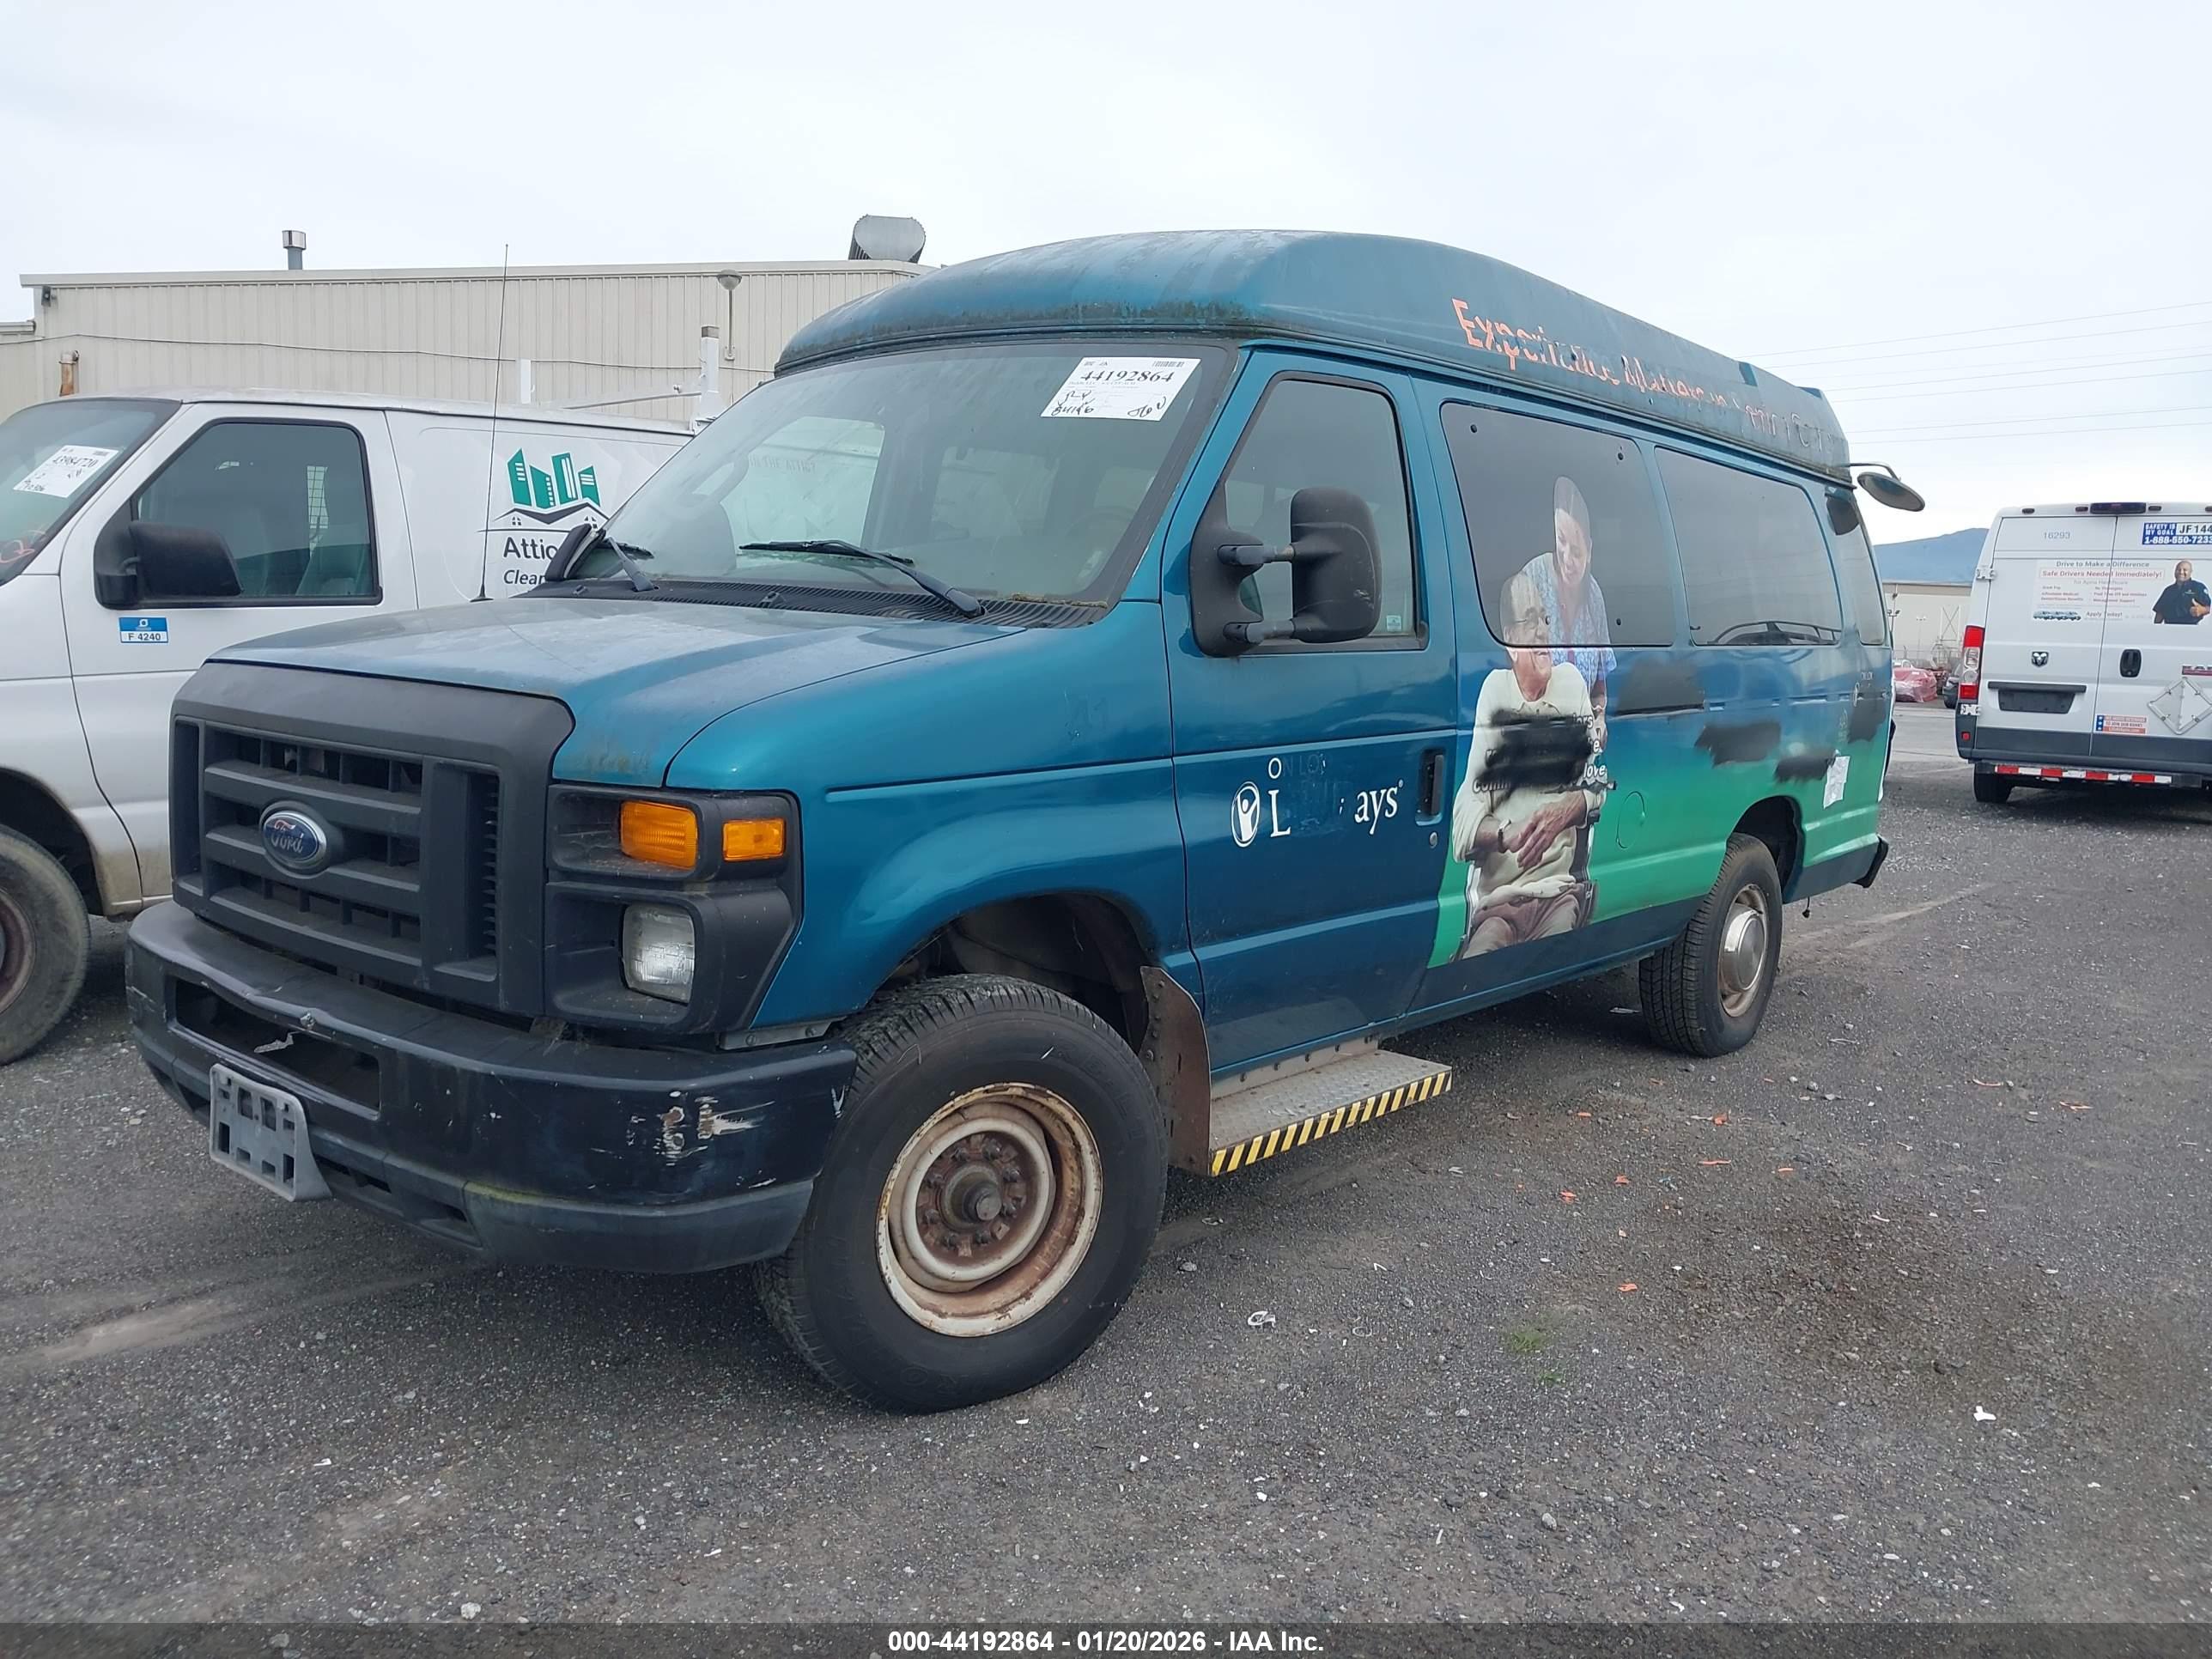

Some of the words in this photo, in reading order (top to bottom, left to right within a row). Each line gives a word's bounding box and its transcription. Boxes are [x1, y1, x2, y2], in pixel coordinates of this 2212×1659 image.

[1081, 370, 1175, 382] 44192864
[2044, 531, 2070, 539] 16293
[2115, 570, 2162, 579] Immediately!
[128, 632, 135, 641] F
[137, 632, 161, 641] 4240
[270, 819, 305, 854] Ford
